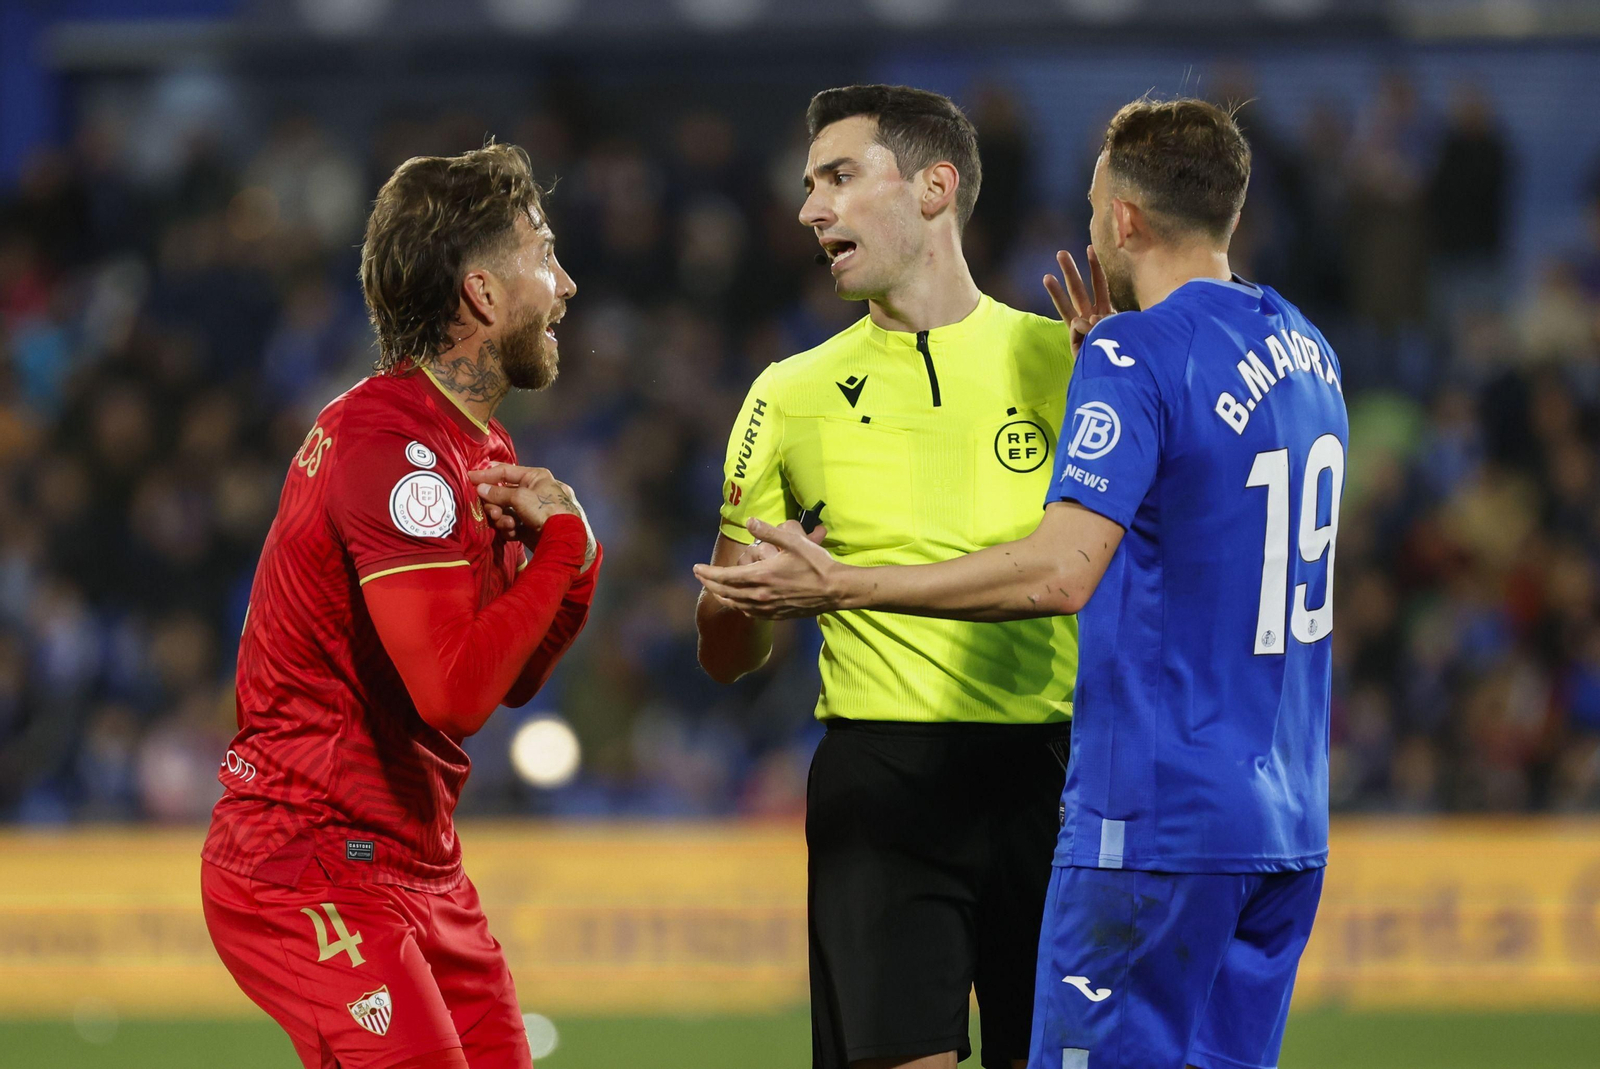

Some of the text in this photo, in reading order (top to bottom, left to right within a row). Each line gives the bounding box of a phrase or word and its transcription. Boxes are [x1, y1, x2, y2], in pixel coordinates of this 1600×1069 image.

[416, 449, 427, 459] 5
[733, 398, 767, 479] WÜRTH
[1245, 432, 1345, 656] 19
[299, 902, 367, 968] 4
